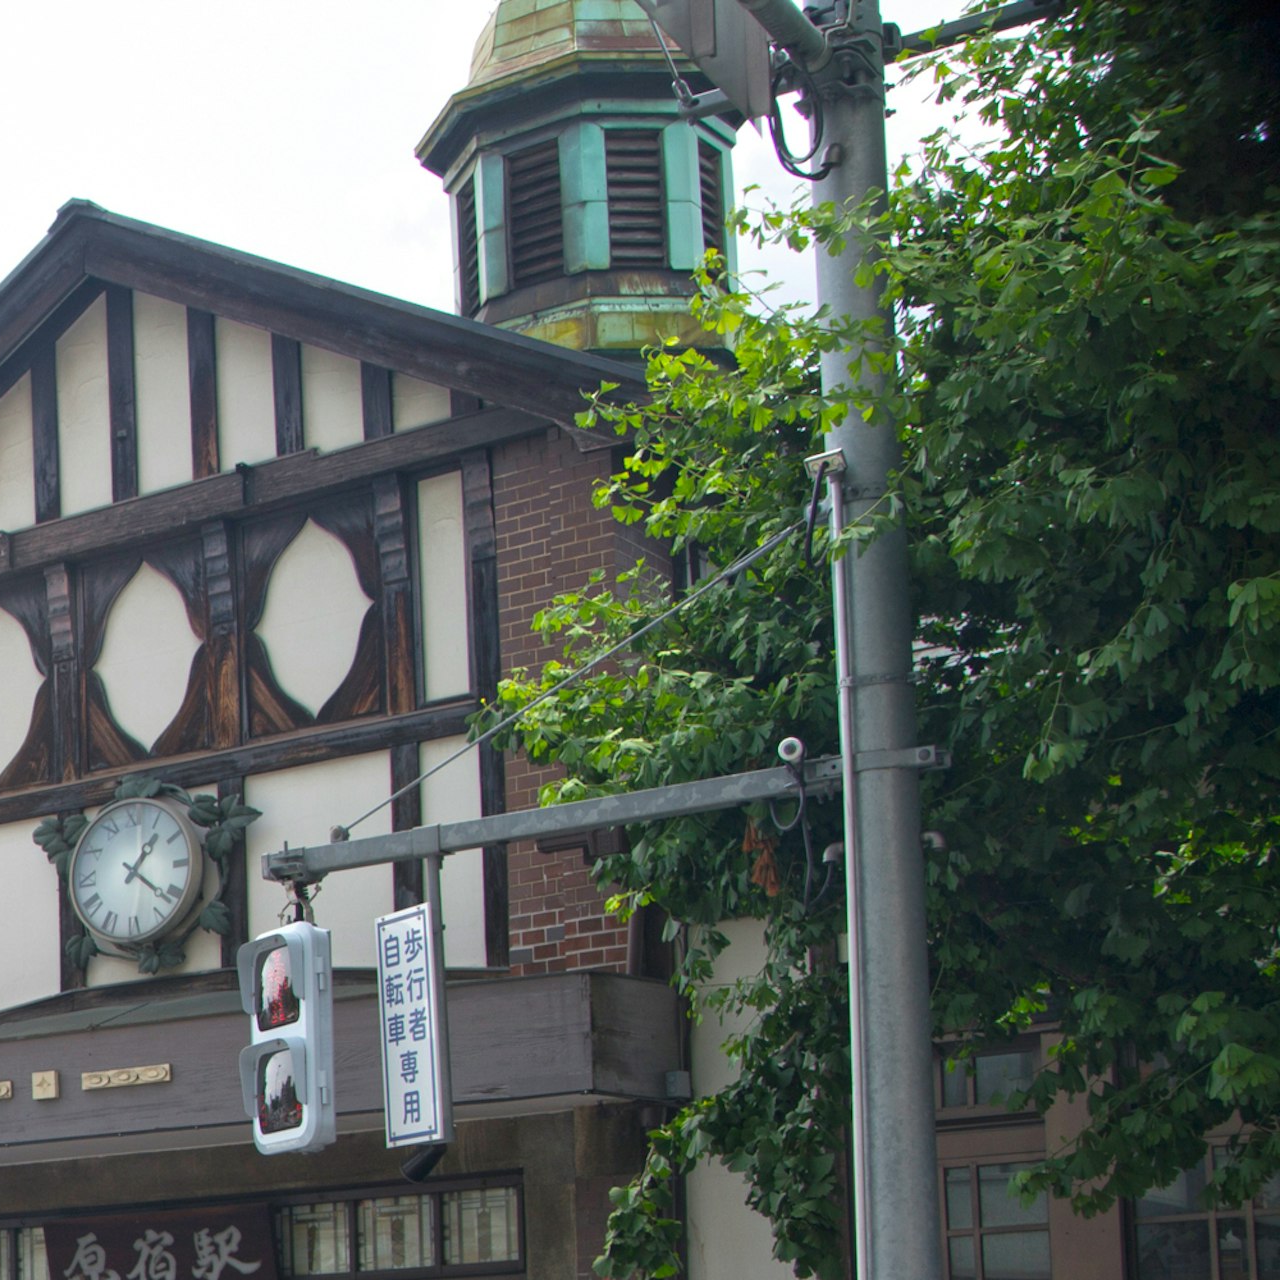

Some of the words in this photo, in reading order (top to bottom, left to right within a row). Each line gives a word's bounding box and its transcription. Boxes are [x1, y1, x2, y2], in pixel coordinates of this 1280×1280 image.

[384, 934, 406, 1046] 自転車
[404, 928, 427, 1042] 歩行者
[400, 1050, 422, 1125] 専用
